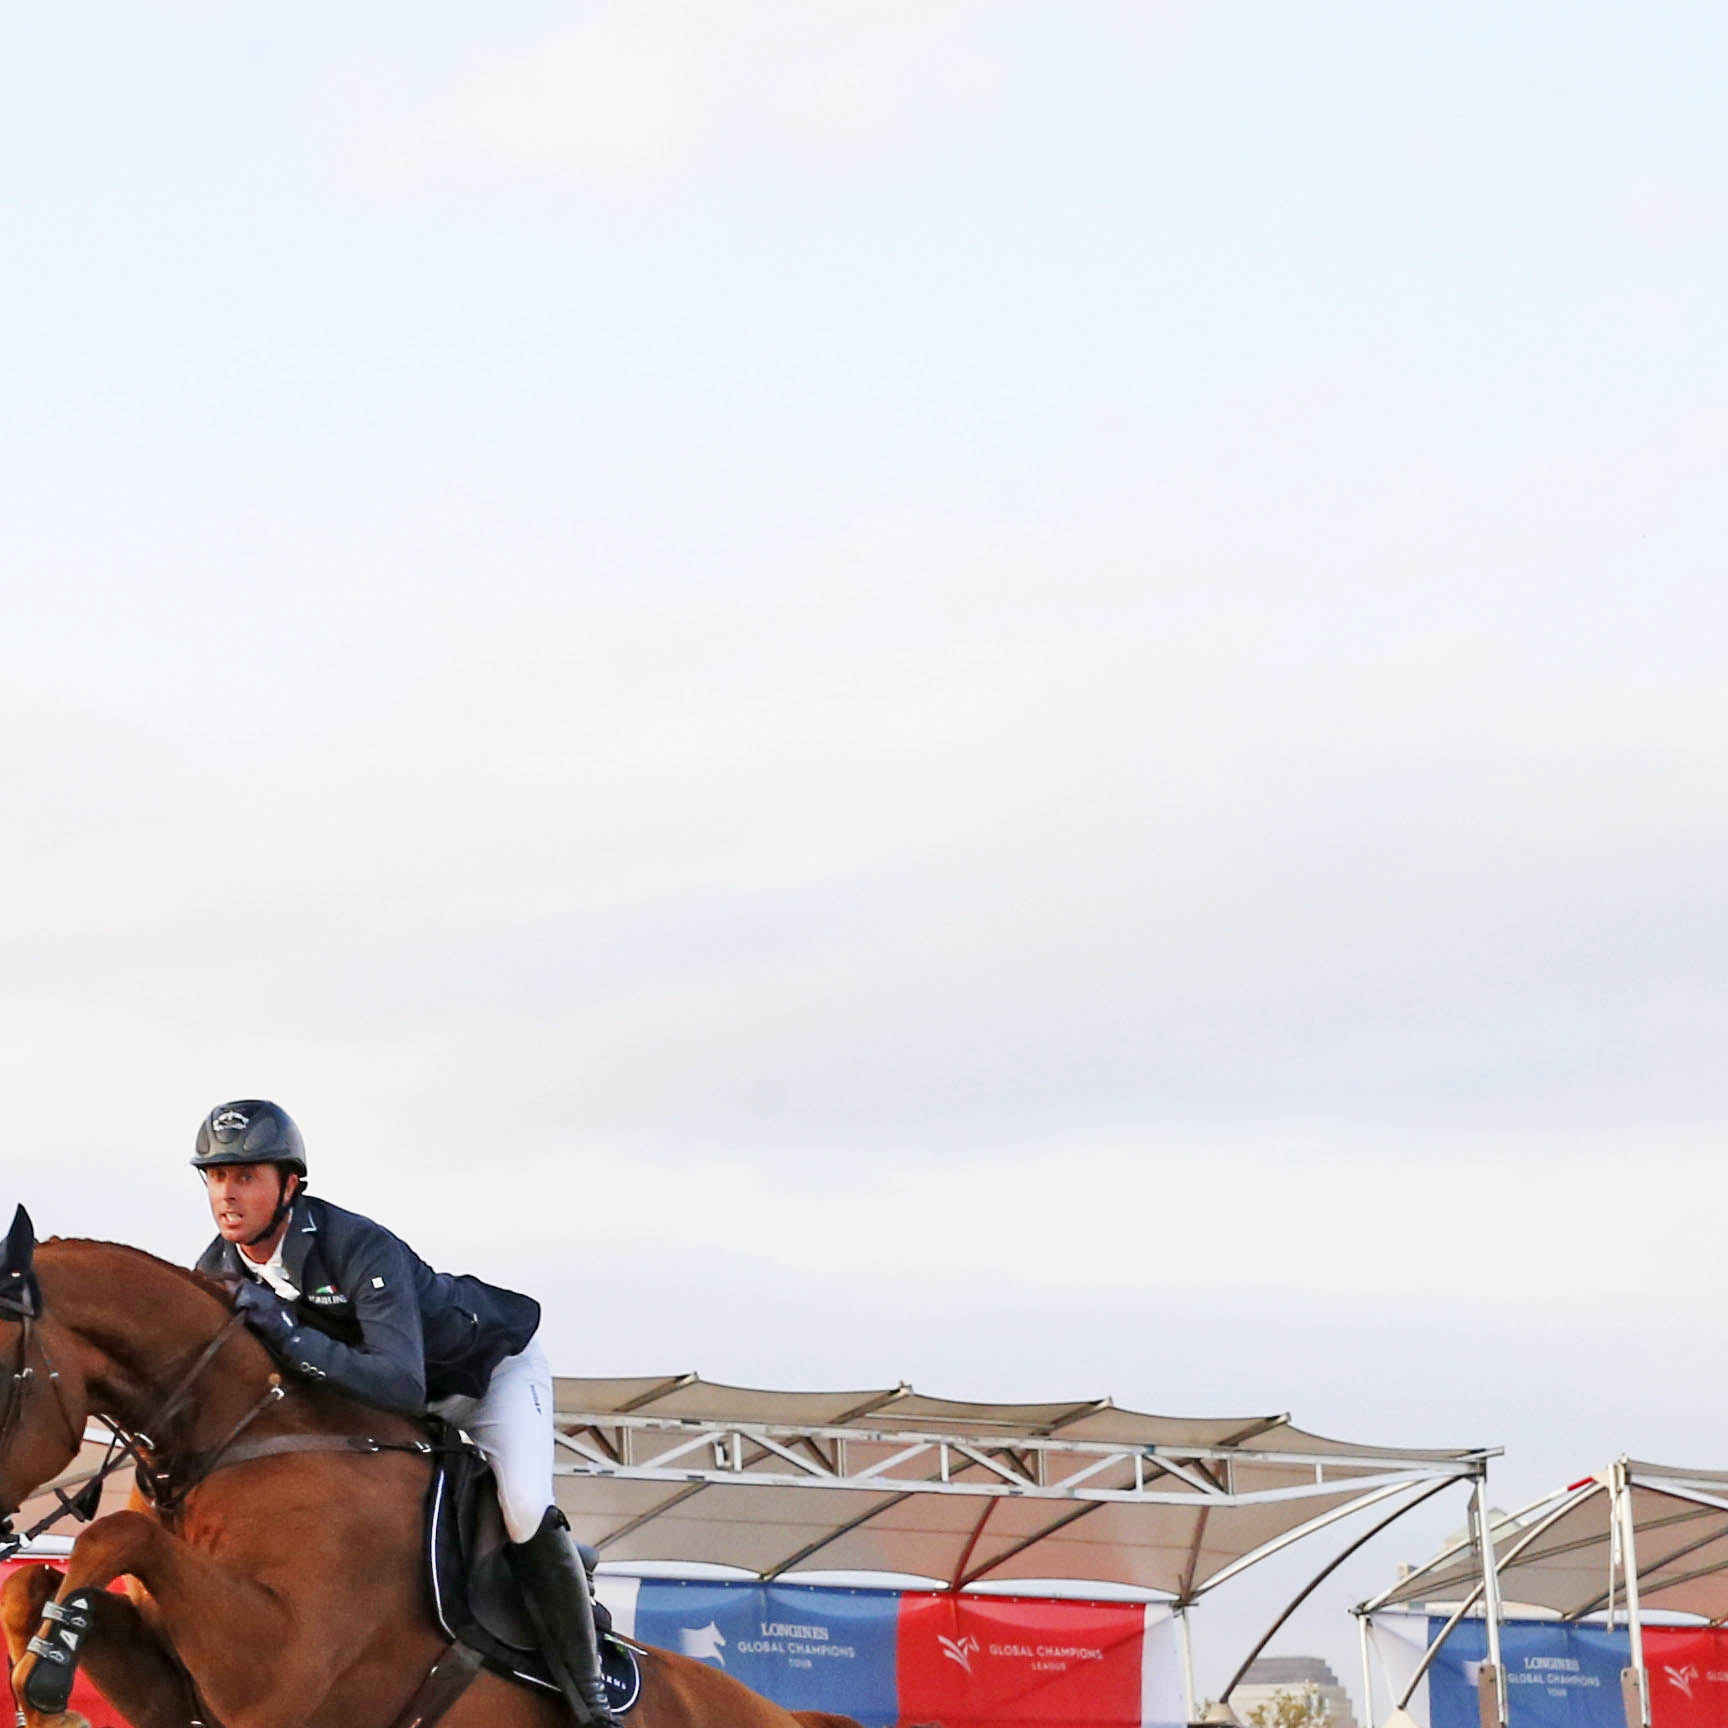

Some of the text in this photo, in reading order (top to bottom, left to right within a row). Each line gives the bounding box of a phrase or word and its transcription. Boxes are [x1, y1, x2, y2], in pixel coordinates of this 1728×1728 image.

[761, 1622, 828, 1640] LONGINES
[738, 1641, 784, 1653] GLOBAL
[989, 1644, 1103, 1660] GLOBAL CHAMPIONS
